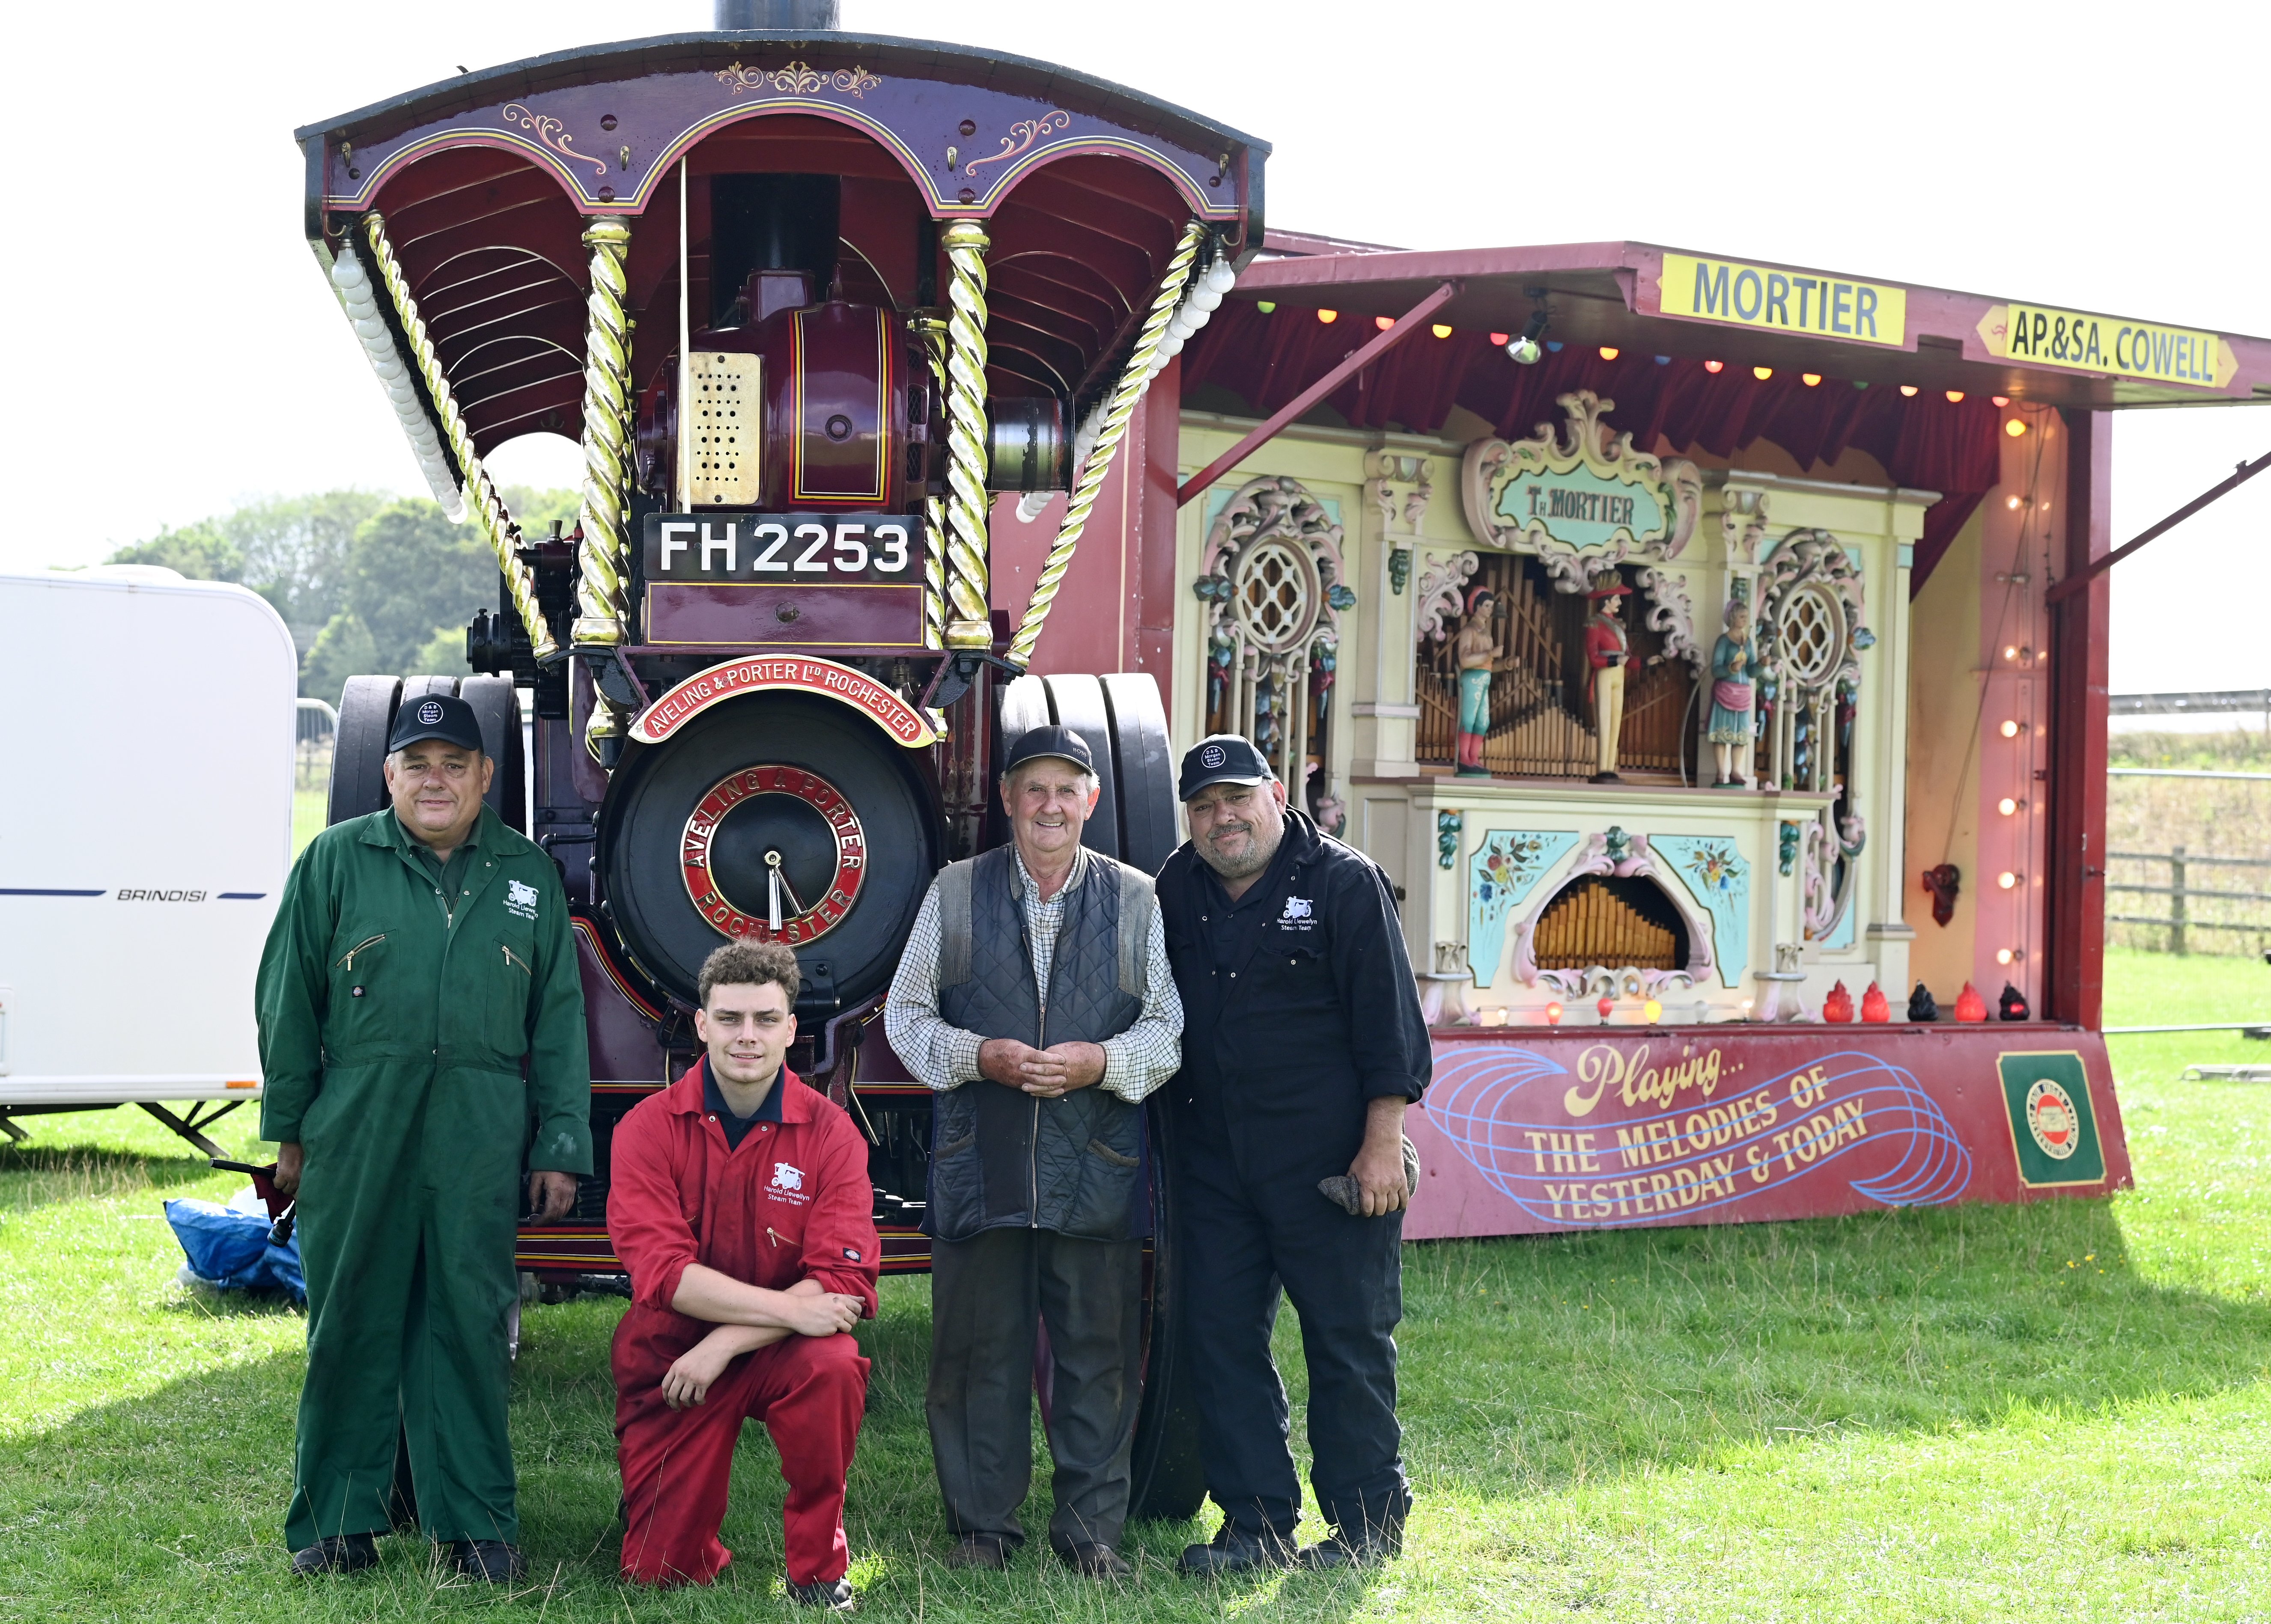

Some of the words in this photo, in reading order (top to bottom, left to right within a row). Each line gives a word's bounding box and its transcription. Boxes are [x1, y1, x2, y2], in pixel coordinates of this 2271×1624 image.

[1693, 262, 1878, 338] MORTIER
[2116, 327, 2213, 382] COWELL
[1549, 488, 1635, 525] MORTIER
[660, 522, 736, 571] FH
[753, 523, 908, 572] 2253
[650, 681, 712, 735] AVELING
[715, 676, 725, 690] &
[728, 663, 797, 687] PORTER
[825, 672, 917, 738] ROCHESTER
[1073, 747, 1087, 757] BOSS
[685, 772, 760, 868] AVELING
[774, 770, 786, 787] &
[799, 778, 861, 869] PORTER
[117, 889, 208, 902] BRINDISI
[503, 899, 519, 909] Harold
[508, 907, 525, 917] Steam
[697, 890, 852, 943] ROCHESTER
[1524, 1131, 1600, 1173] THE
[1616, 1090, 1778, 1169] MELODIES
[1790, 1065, 1830, 1109] OF
[1544, 1153, 1737, 1220] YESTERDAY
[1746, 1145, 1770, 1184] &
[1773, 1098, 1868, 1172] TODAY
[763, 1185, 783, 1194] Harold
[784, 1190, 810, 1201] Llewellyn
[767, 1193, 787, 1203] Steam
[788, 1198, 802, 1206] Team
